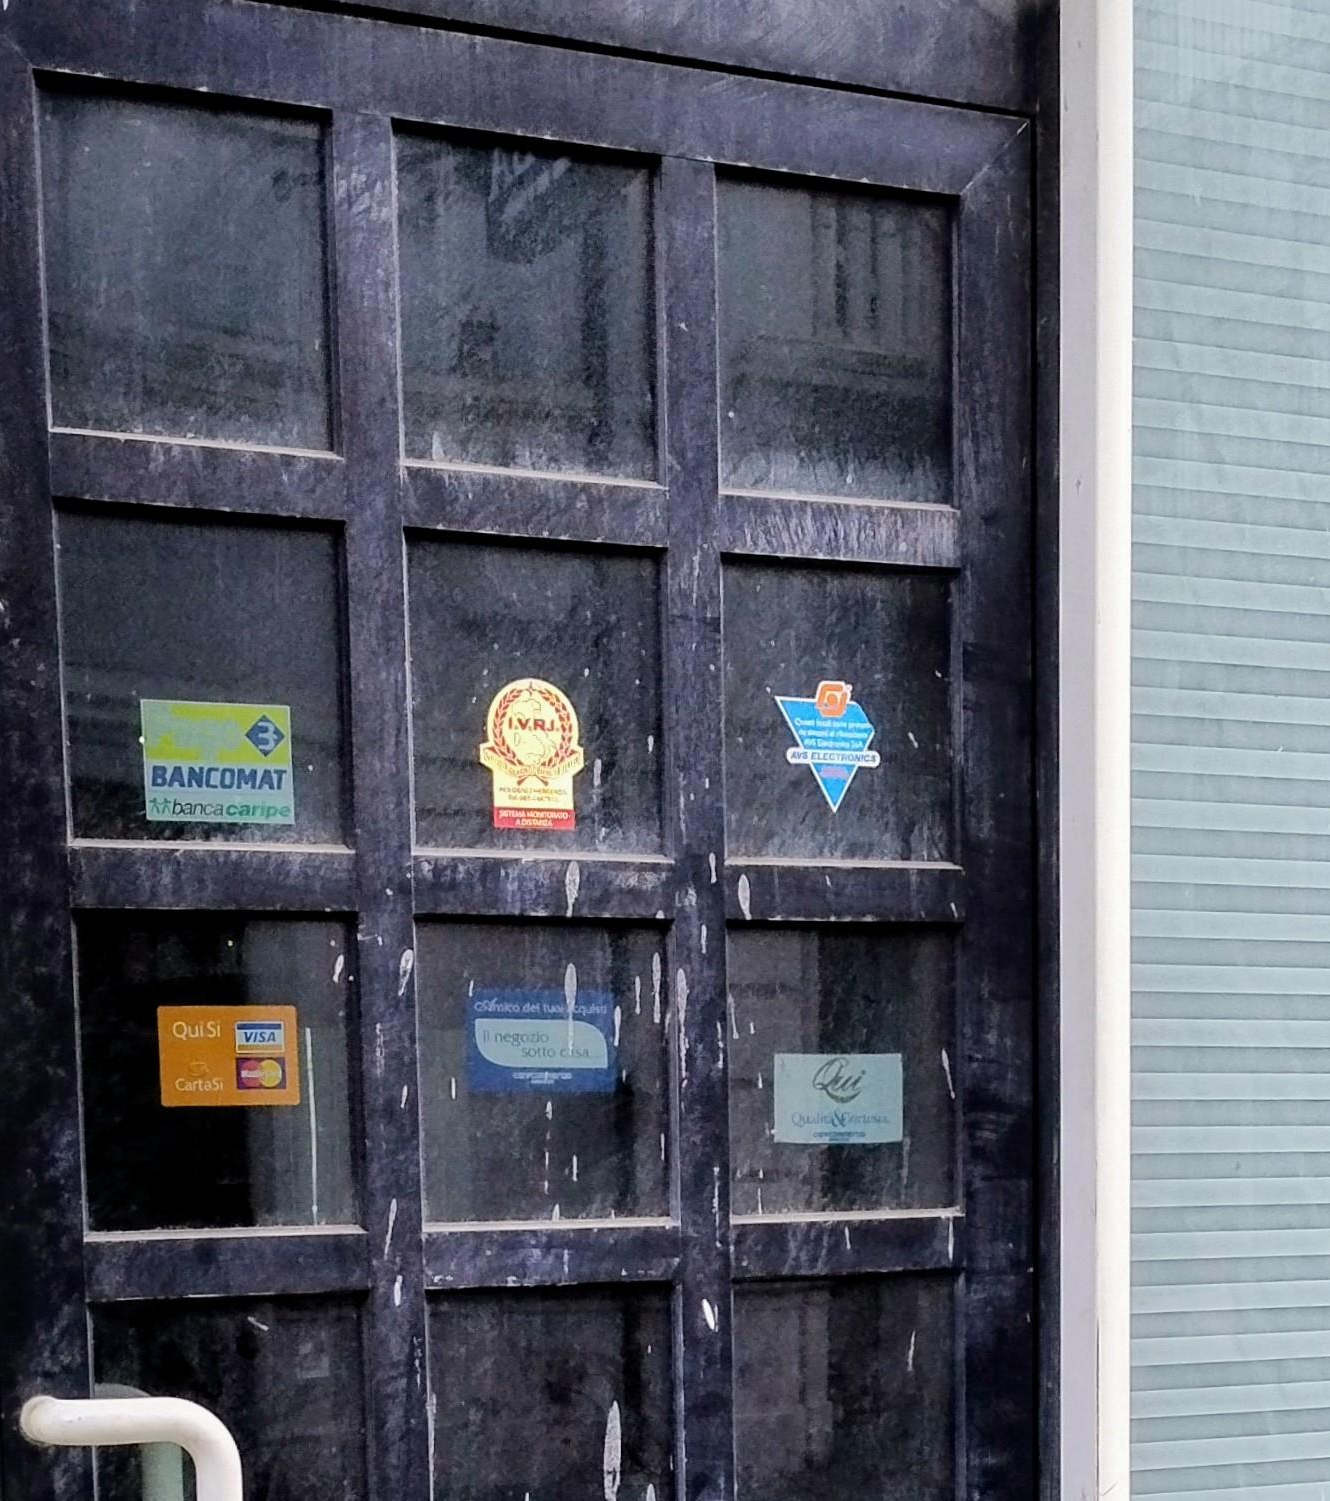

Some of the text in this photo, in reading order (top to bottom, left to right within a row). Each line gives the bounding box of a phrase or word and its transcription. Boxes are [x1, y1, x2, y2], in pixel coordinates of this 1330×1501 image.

[811, 752, 876, 763] ELECTRONICS
[151, 765, 287, 790] BANCOMAT
[173, 1020, 221, 1040] Qui Si
[243, 1031, 277, 1043] VISA
[494, 1031, 549, 1045] negozio
[521, 1047, 556, 1058] sotto
